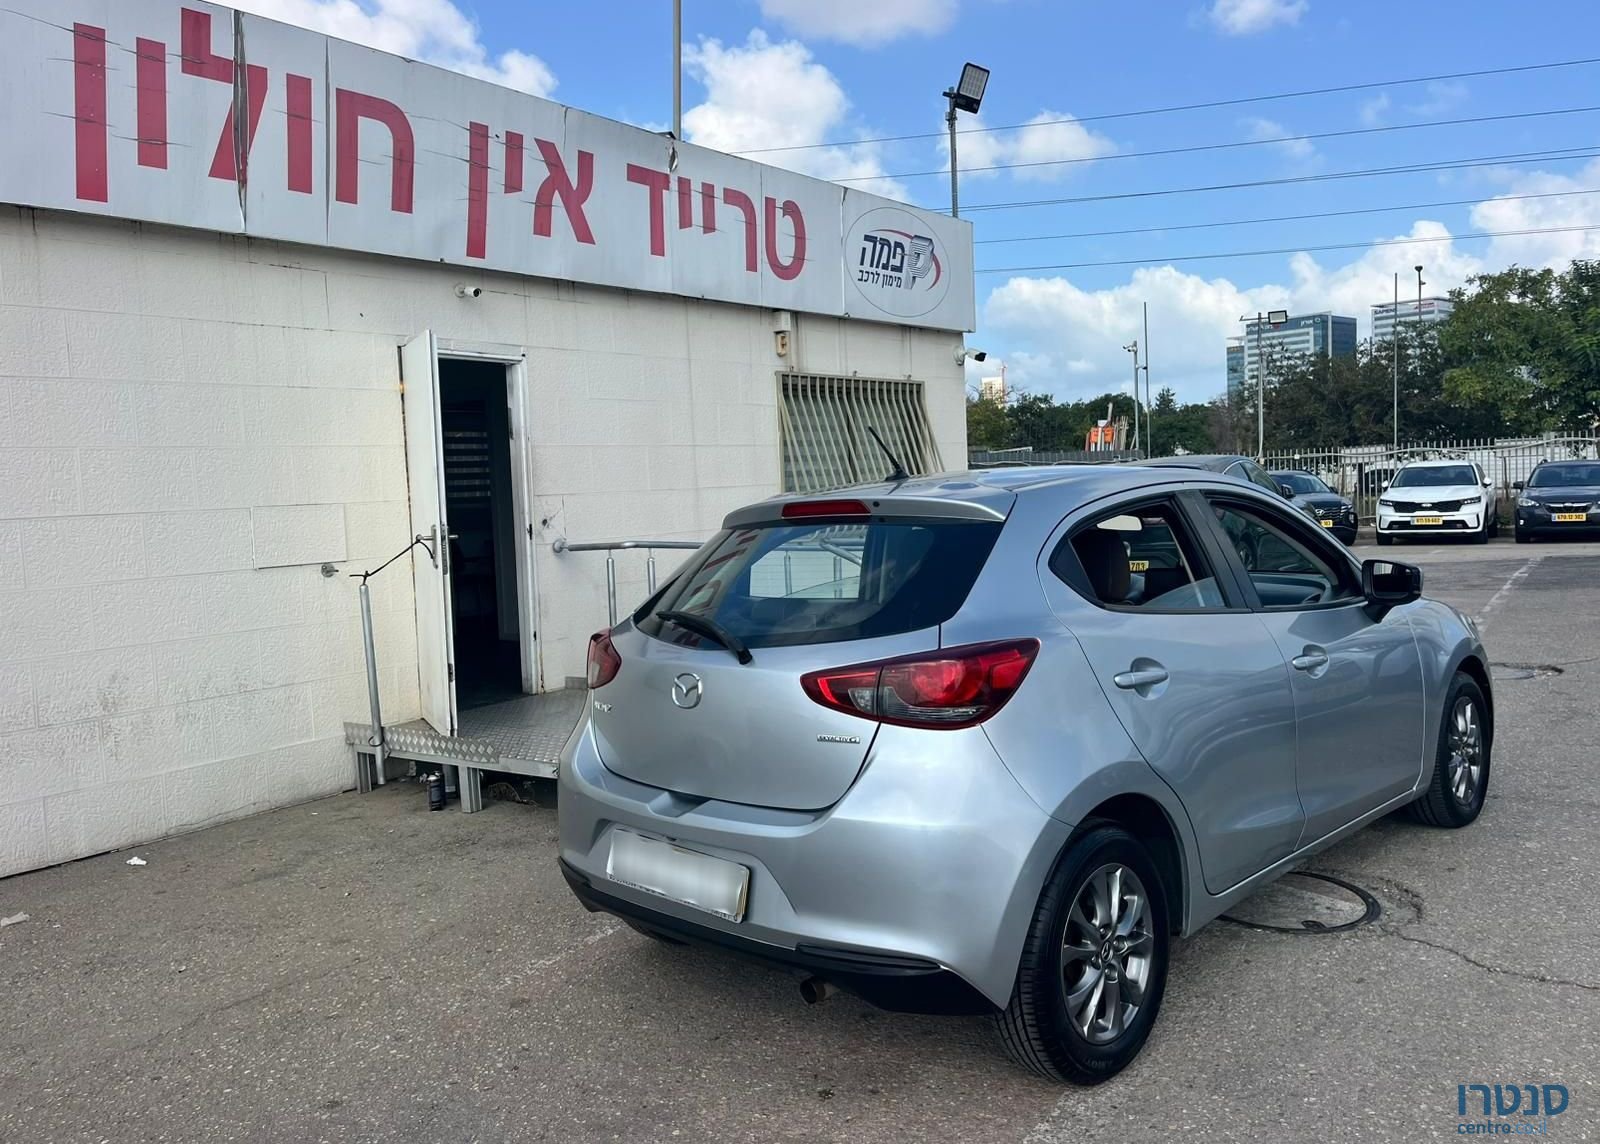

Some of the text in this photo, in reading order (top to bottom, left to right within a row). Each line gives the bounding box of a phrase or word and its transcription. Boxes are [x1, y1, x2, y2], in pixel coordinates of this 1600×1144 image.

[73, 7, 807, 281] טרייד אין חולון
[859, 234, 906, 273] פמה
[857, 269, 902, 289] מימון לרכב
